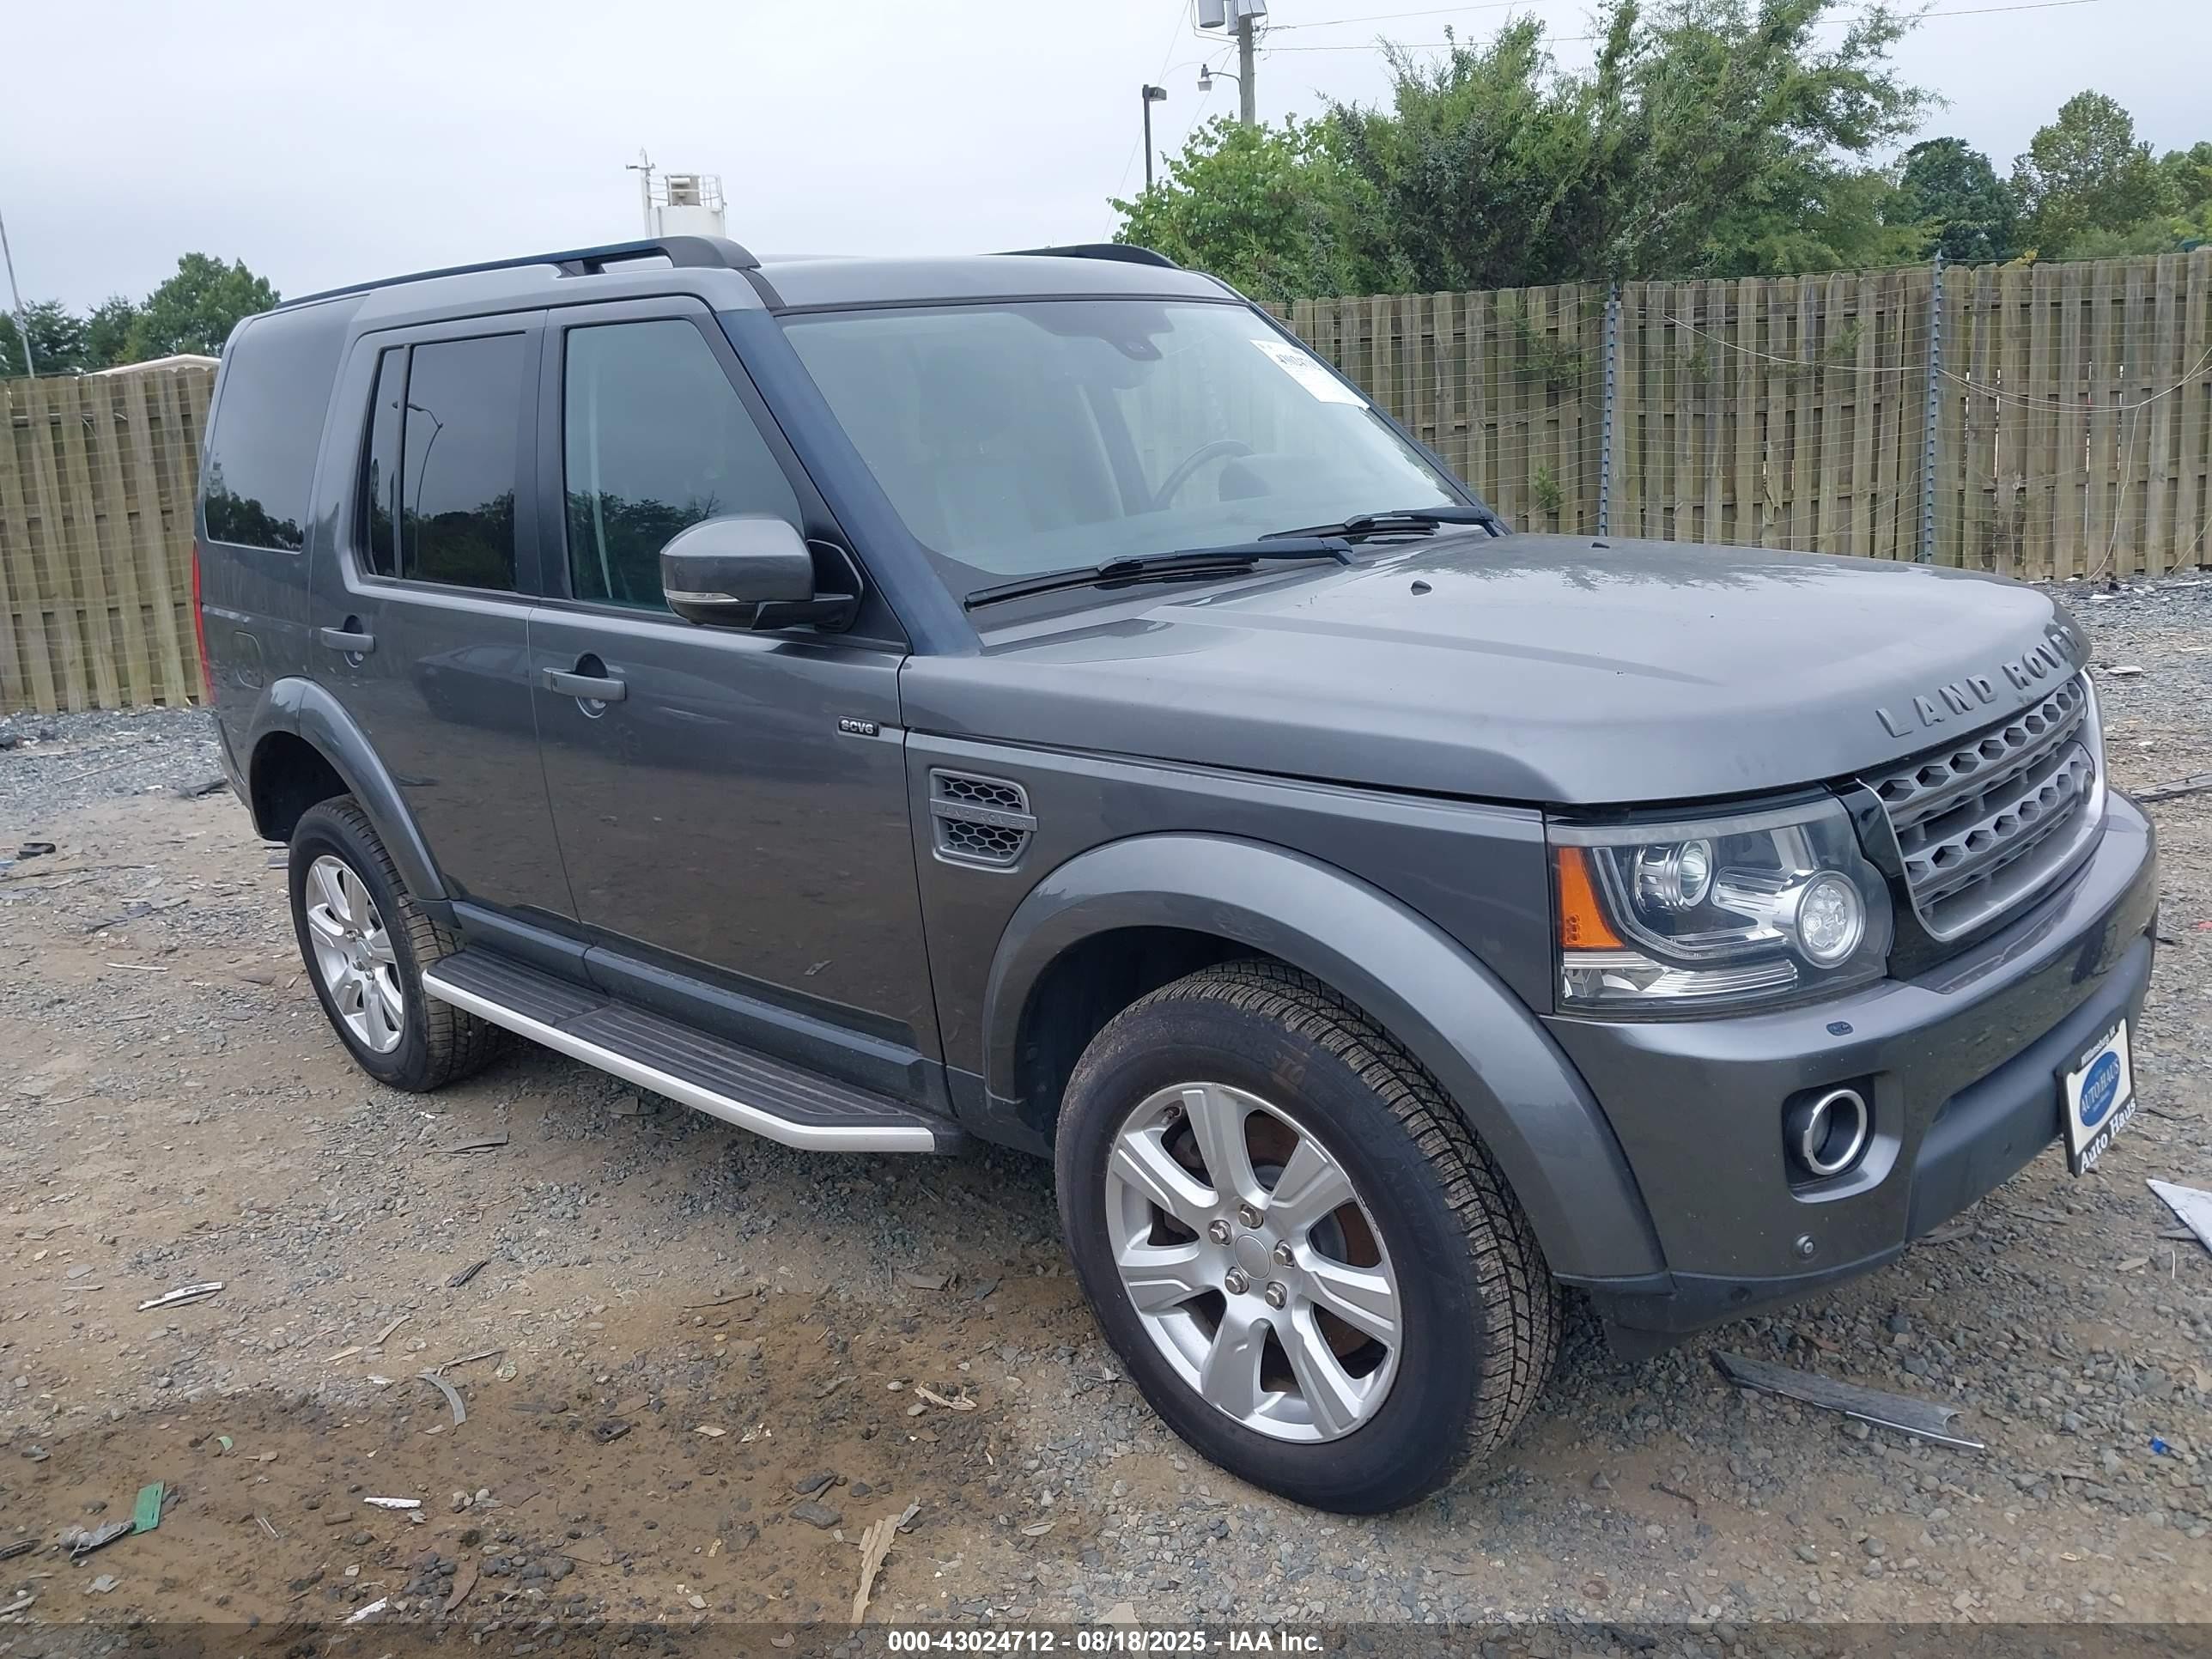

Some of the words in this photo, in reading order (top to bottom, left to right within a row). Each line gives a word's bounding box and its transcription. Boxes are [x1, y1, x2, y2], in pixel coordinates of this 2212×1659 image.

[1875, 674, 1997, 738] LAND
[2002, 626, 2081, 690] ROVER
[2081, 1133, 2108, 1174] Auto
[2109, 1097, 2136, 1138] Haus
